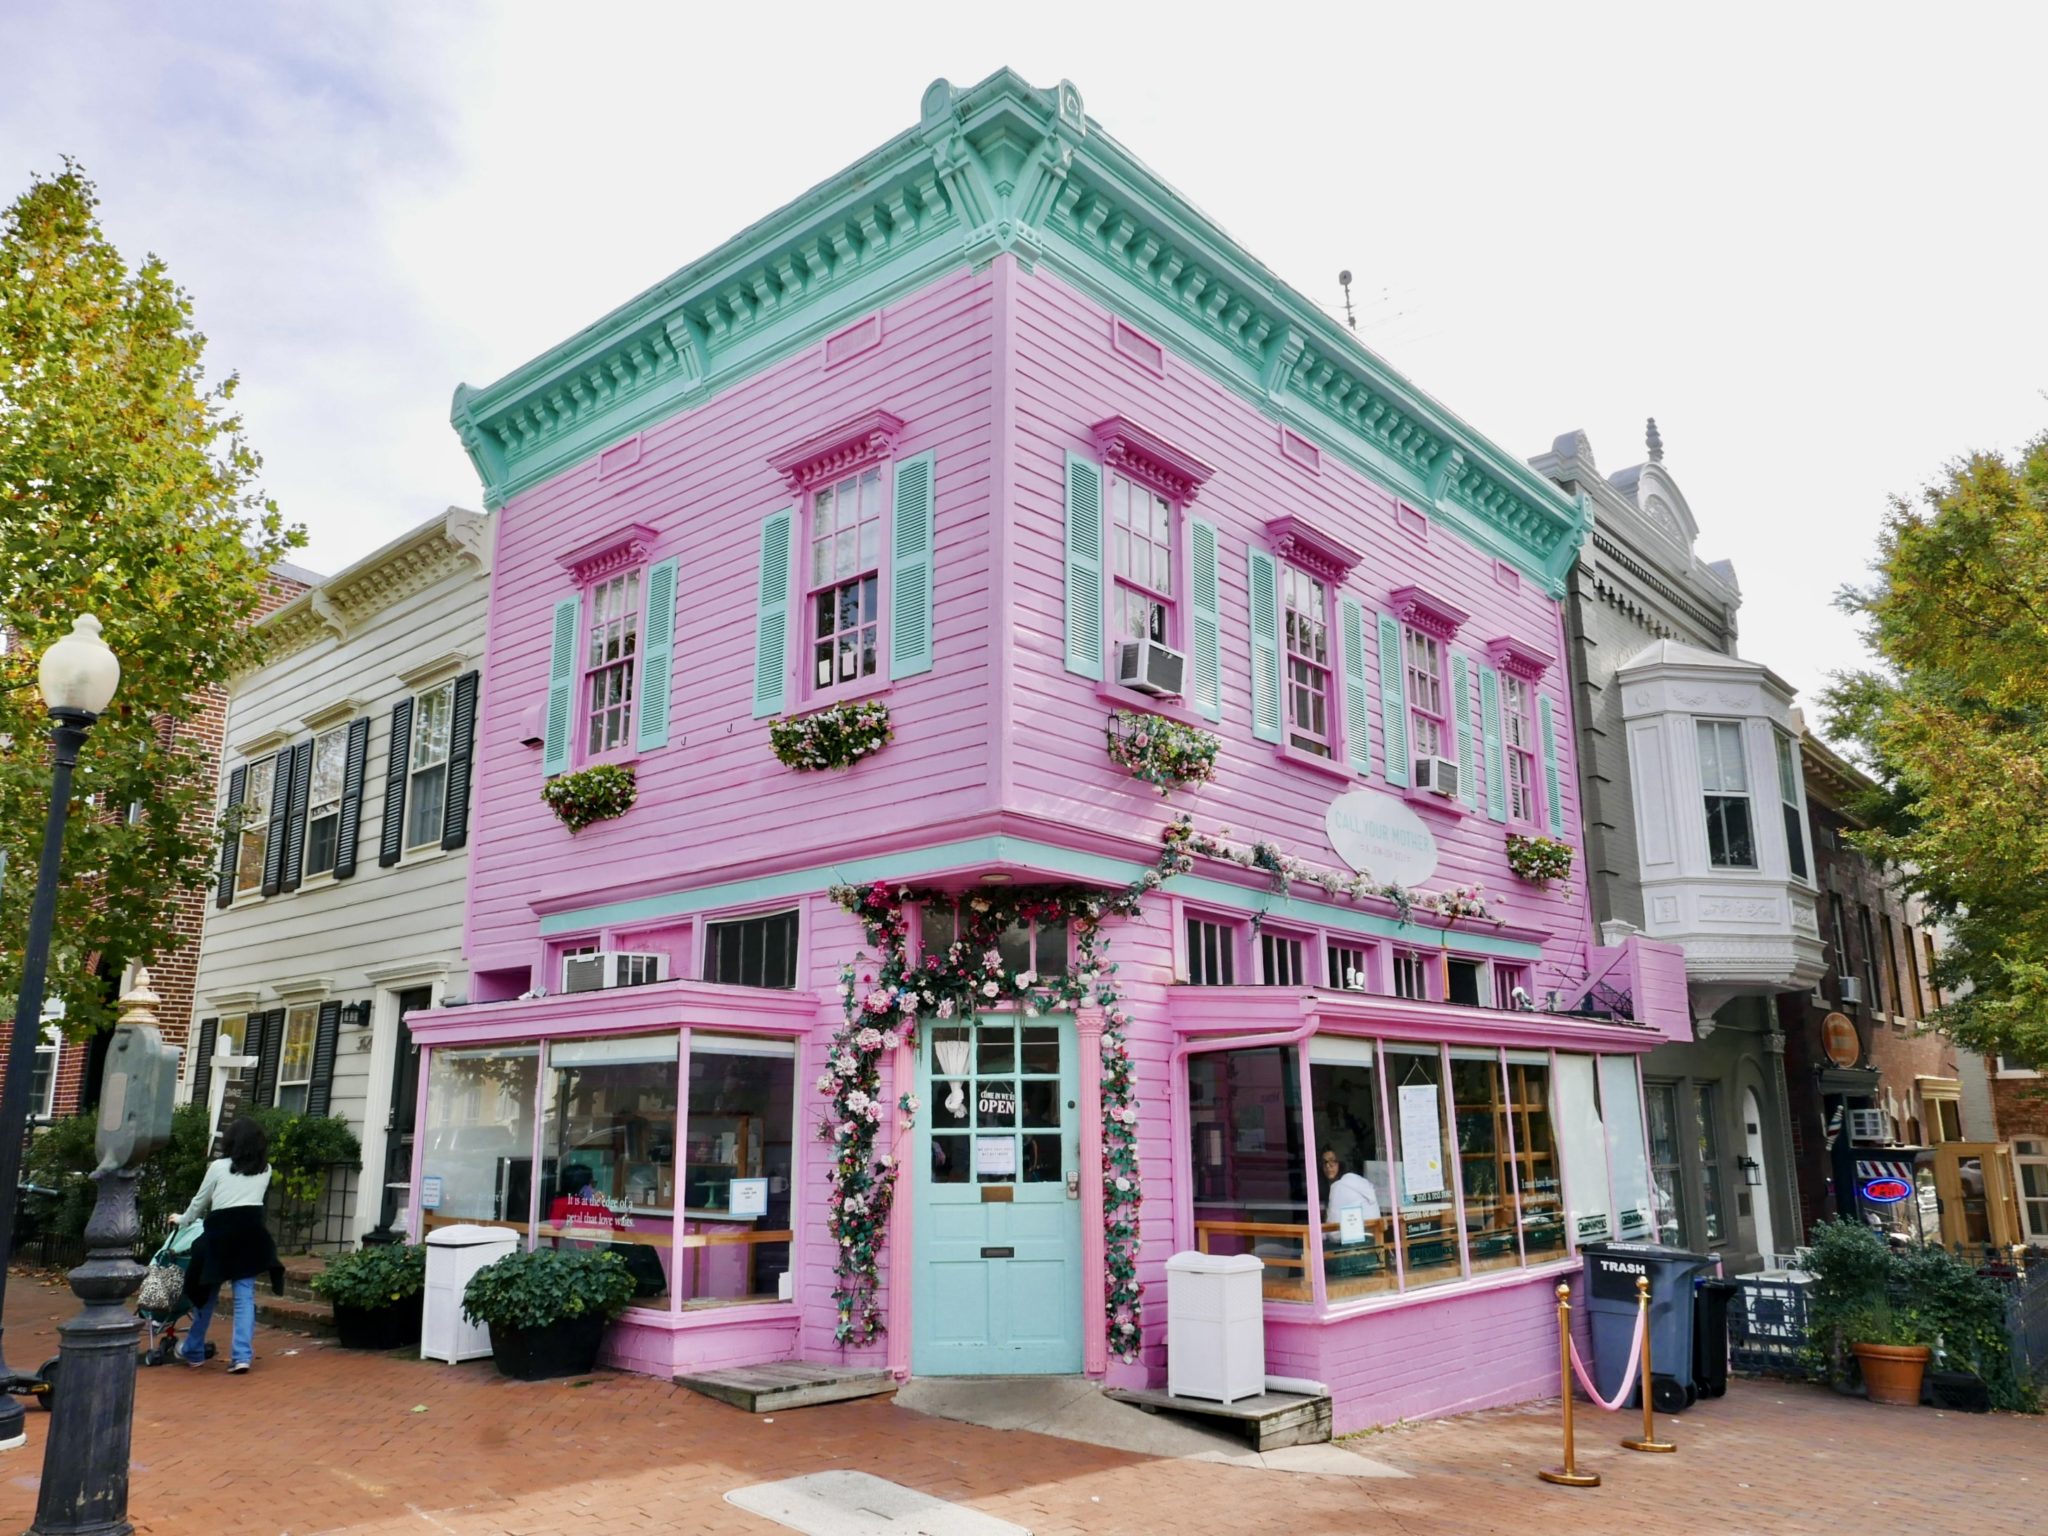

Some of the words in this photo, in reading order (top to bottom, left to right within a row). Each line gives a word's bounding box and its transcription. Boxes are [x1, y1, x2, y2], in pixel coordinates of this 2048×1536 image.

[1335, 810, 1361, 834] CALL
[1363, 819, 1389, 841] YOUR
[1391, 826, 1430, 853] MOTHER
[980, 1091, 994, 1099] COME
[979, 1099, 1015, 1114] OPEN
[567, 1193, 574, 1205] It
[574, 1194, 581, 1206] is
[581, 1196, 588, 1206] at
[589, 1194, 601, 1207] the
[601, 1195, 618, 1208] edge
[619, 1196, 629, 1208] of
[629, 1200, 633, 1209] a
[566, 1212, 583, 1225] petal
[583, 1211, 598, 1224] that
[598, 1212, 613, 1225] love
[1600, 1260, 1646, 1275] TRASH
